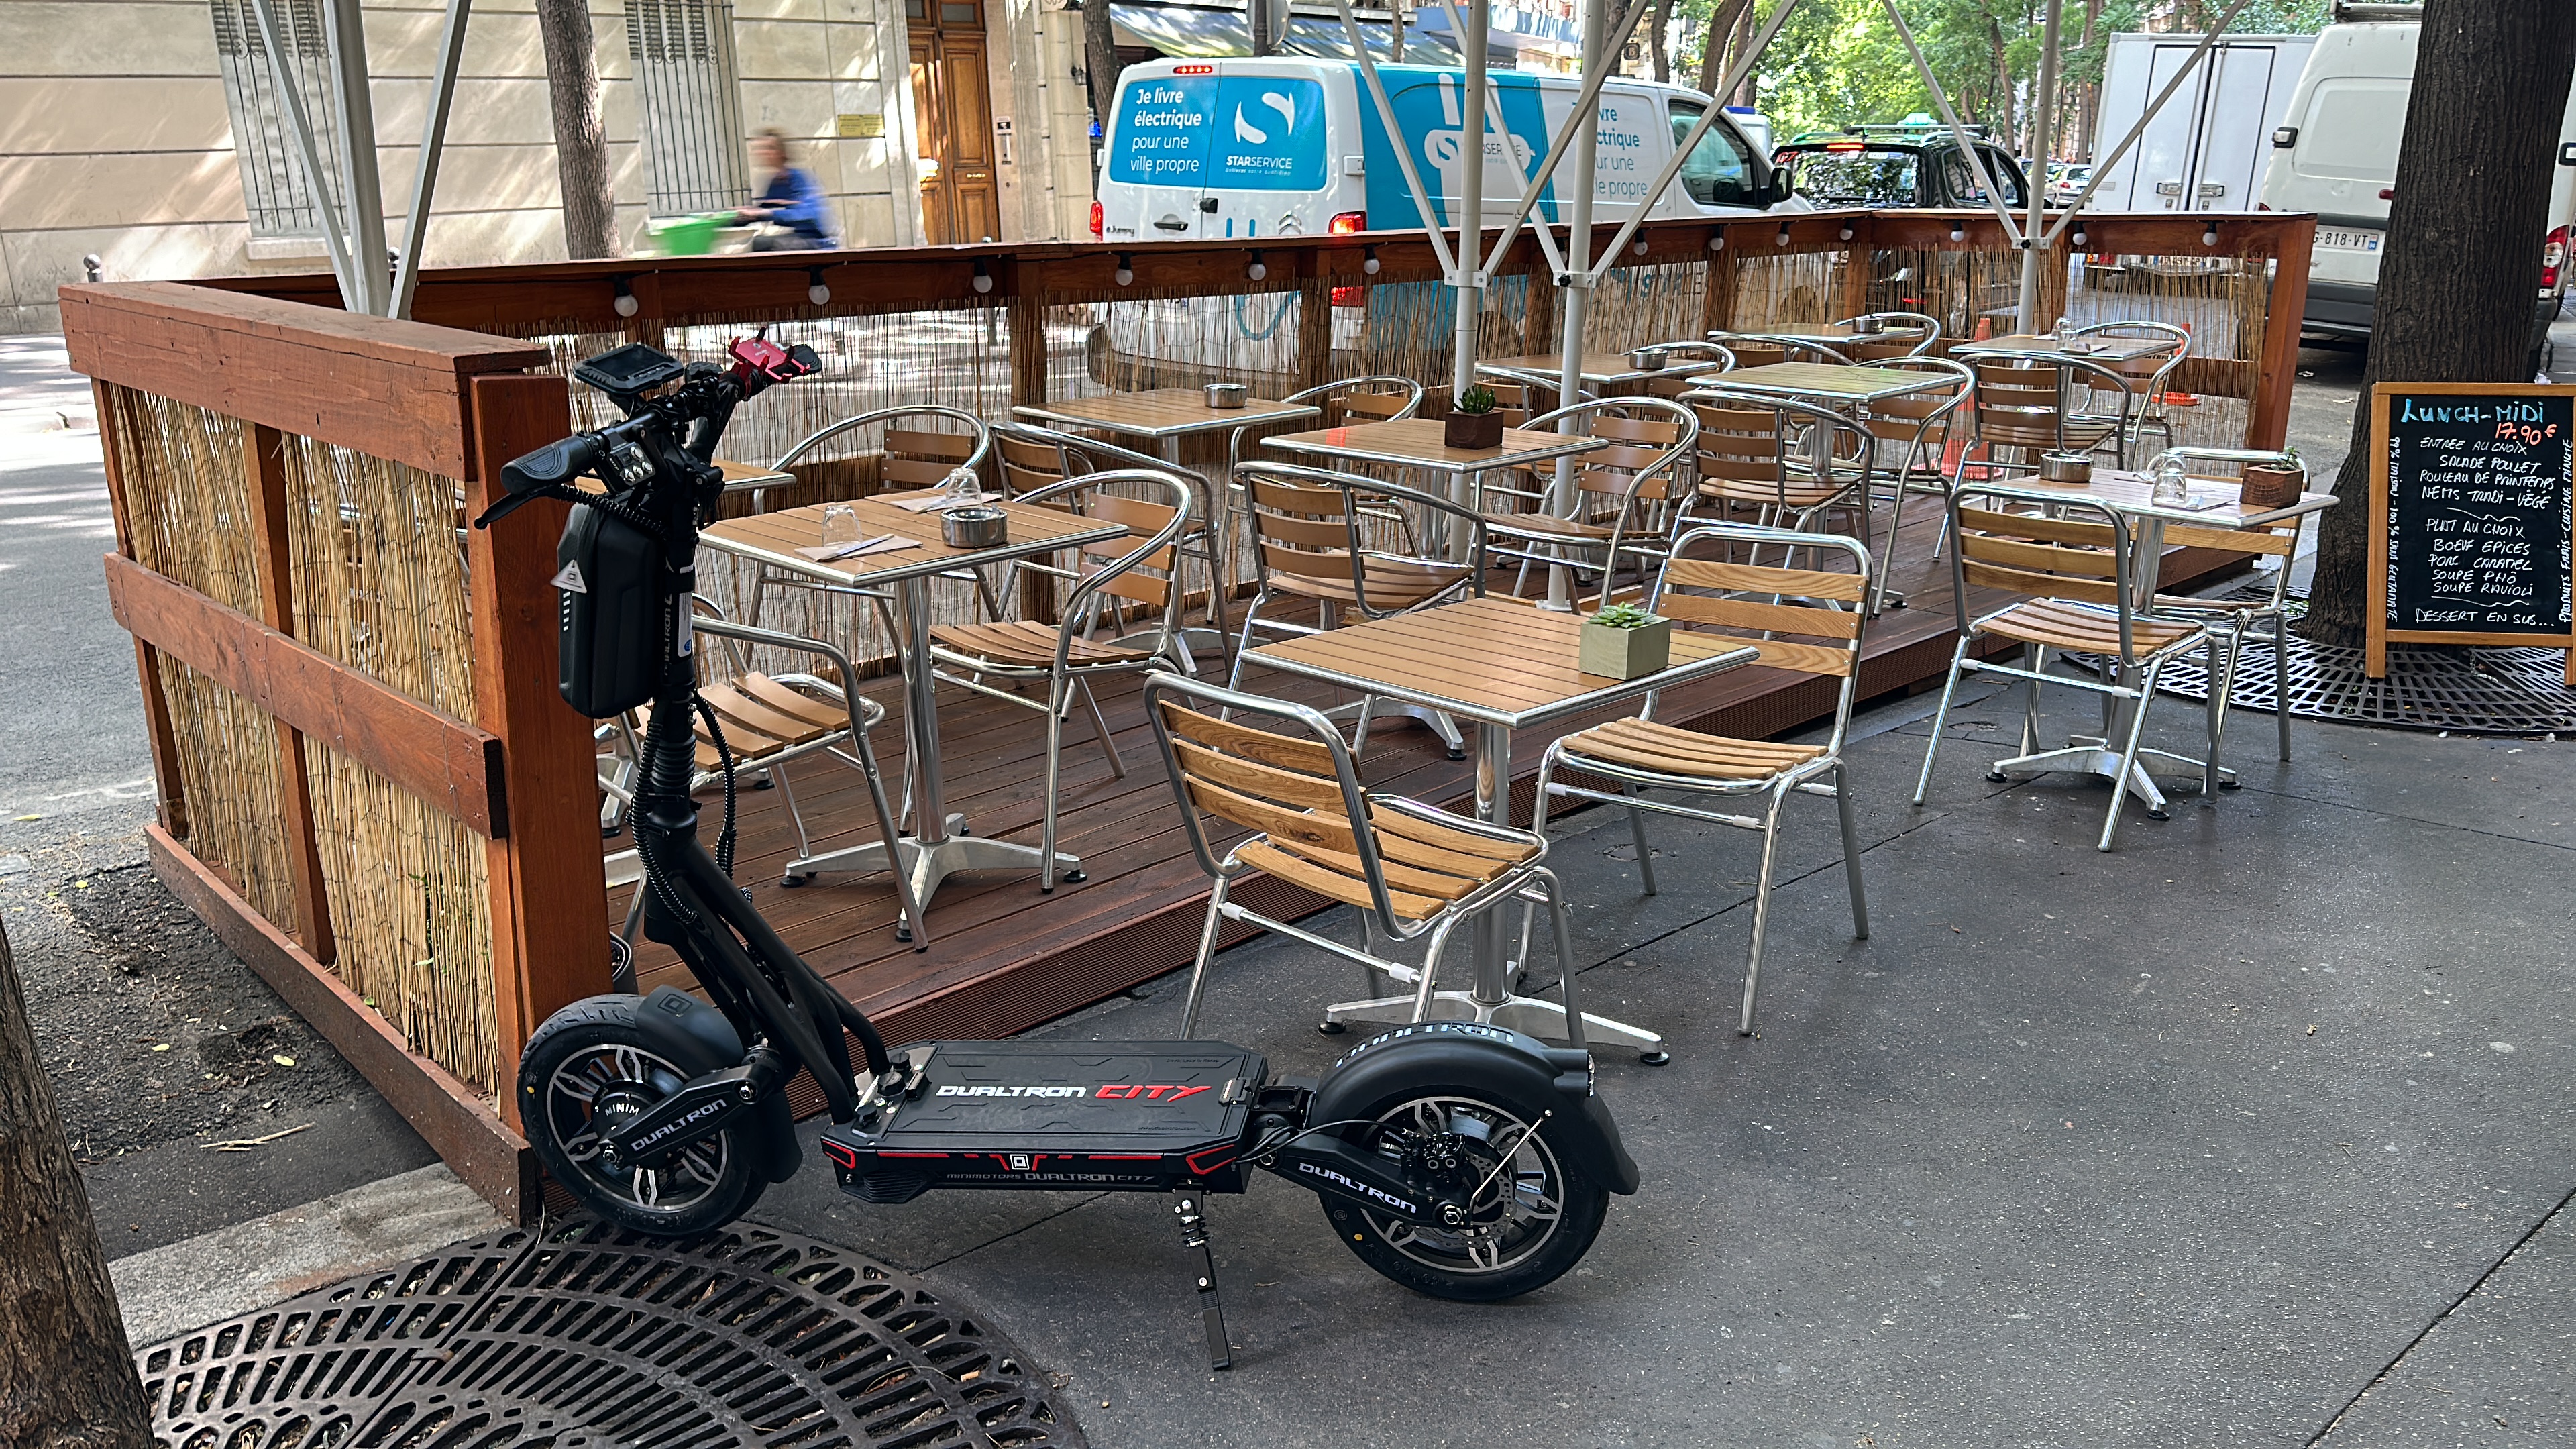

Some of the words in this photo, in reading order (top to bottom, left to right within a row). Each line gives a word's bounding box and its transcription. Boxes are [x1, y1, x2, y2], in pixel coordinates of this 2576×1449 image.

[1136, 89, 1152, 104] Je
[1154, 87, 1184, 103] livre
[1134, 109, 1202, 129] électrique
[1599, 108, 1617, 121] vre
[1132, 136, 1161, 152] pour
[1163, 136, 1189, 148] une
[1597, 127, 1640, 150] ctrique
[1130, 155, 1153, 171] ville
[1155, 159, 1199, 174] propre
[1226, 155, 1292, 169] STARSERVICE
[1611, 158, 1634, 170] une
[1609, 181, 1648, 199] propre
[2313, 232, 2368, 247] G-818-VT
[2420, 437, 2465, 449] ENTREE
[2472, 441, 2489, 451] AU
[2439, 455, 2486, 469] SALADE
[2491, 457, 2541, 474] POULET
[2420, 470, 2469, 483] ROULEAU
[2474, 472, 2490, 484] DE
[2422, 486, 2460, 500] NEMS
[2425, 519, 2457, 532] PLAT
[2463, 521, 2479, 533] AU
[2428, 554, 2459, 567] PORC
[2473, 557, 2532, 570] CARAMEL
[2432, 570, 2474, 580] SOUPE
[2434, 582, 2474, 594] SOUPE
[2416, 608, 2478, 623] DESSERT
[2487, 612, 2507, 622] EN
[936, 1085, 1087, 1099] DUALTRON
[1095, 1085, 1212, 1102] CITY
[605, 1102, 640, 1116] MINIM
[631, 1099, 727, 1152] DUALTRON
[1025, 1173, 1115, 1181] DUALTRON
[1299, 1162, 1417, 1214] DUALTRON
